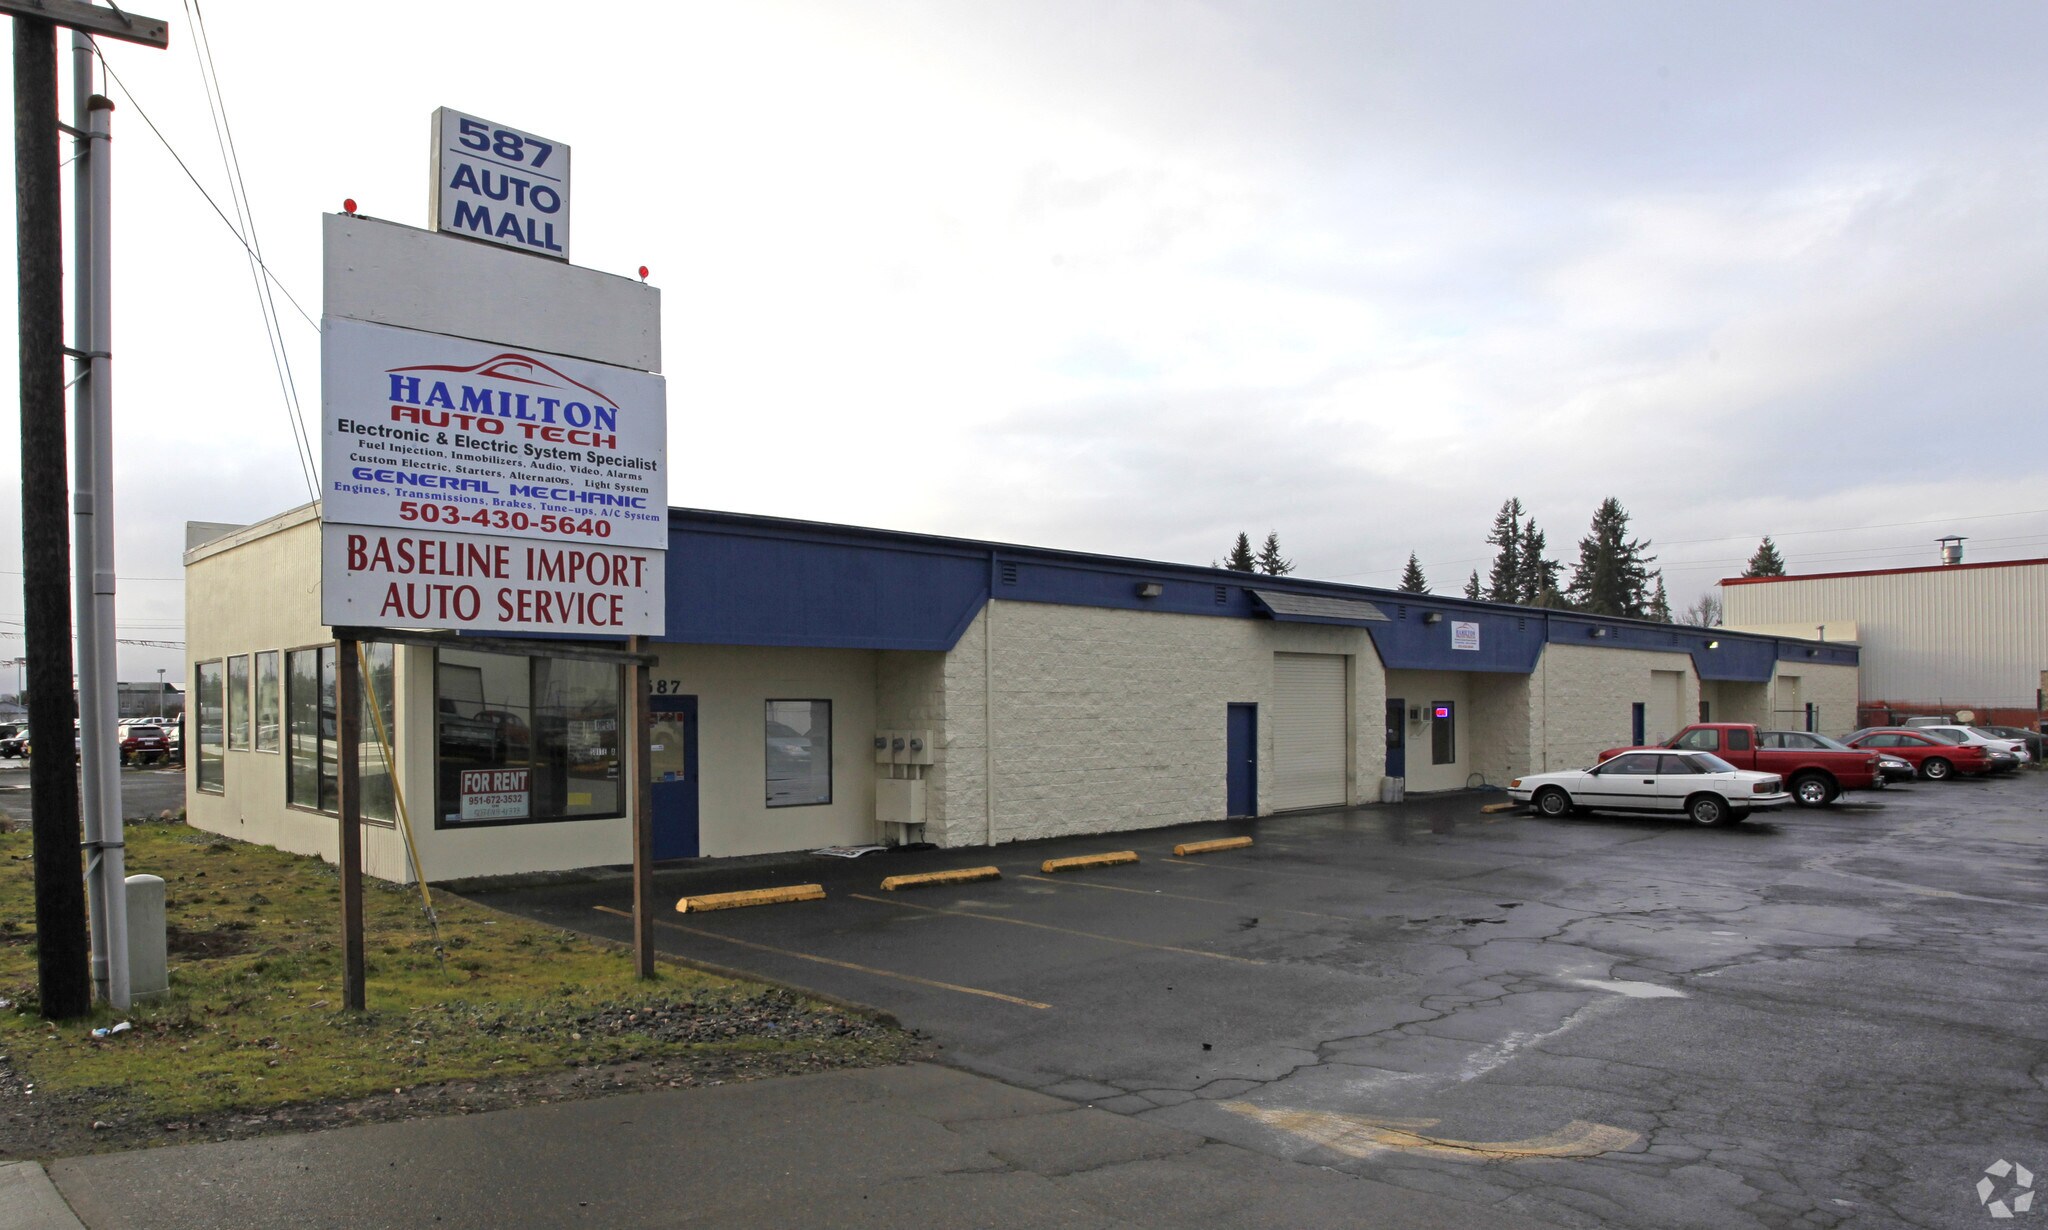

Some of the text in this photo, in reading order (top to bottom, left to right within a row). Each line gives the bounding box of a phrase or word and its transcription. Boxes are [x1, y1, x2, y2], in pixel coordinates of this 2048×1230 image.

[459, 117, 552, 168] 587
[449, 163, 561, 214] AUTO
[453, 200, 563, 252] MALL
[388, 373, 618, 432] HAMILTON
[338, 418, 657, 471] Electronic & Electric System Specialist
[391, 404, 617, 450] AUTO TECH
[350, 453, 397, 466] Custom
[585, 479, 611, 490] Light
[614, 483, 649, 494] System
[358, 439, 385, 450] Fuel
[607, 470, 642, 481] Alarms
[352, 467, 647, 509] GENERAL MECHANIC
[399, 501, 611, 537] 503-430-5640
[601, 508, 621, 518] A/C
[624, 510, 660, 522] System
[348, 534, 647, 588] BASELINE IMPORT
[380, 582, 624, 627] AUTO SERVICE
[464, 771, 527, 793] FOR RENT
[468, 794, 522, 805] 951-672-3532
